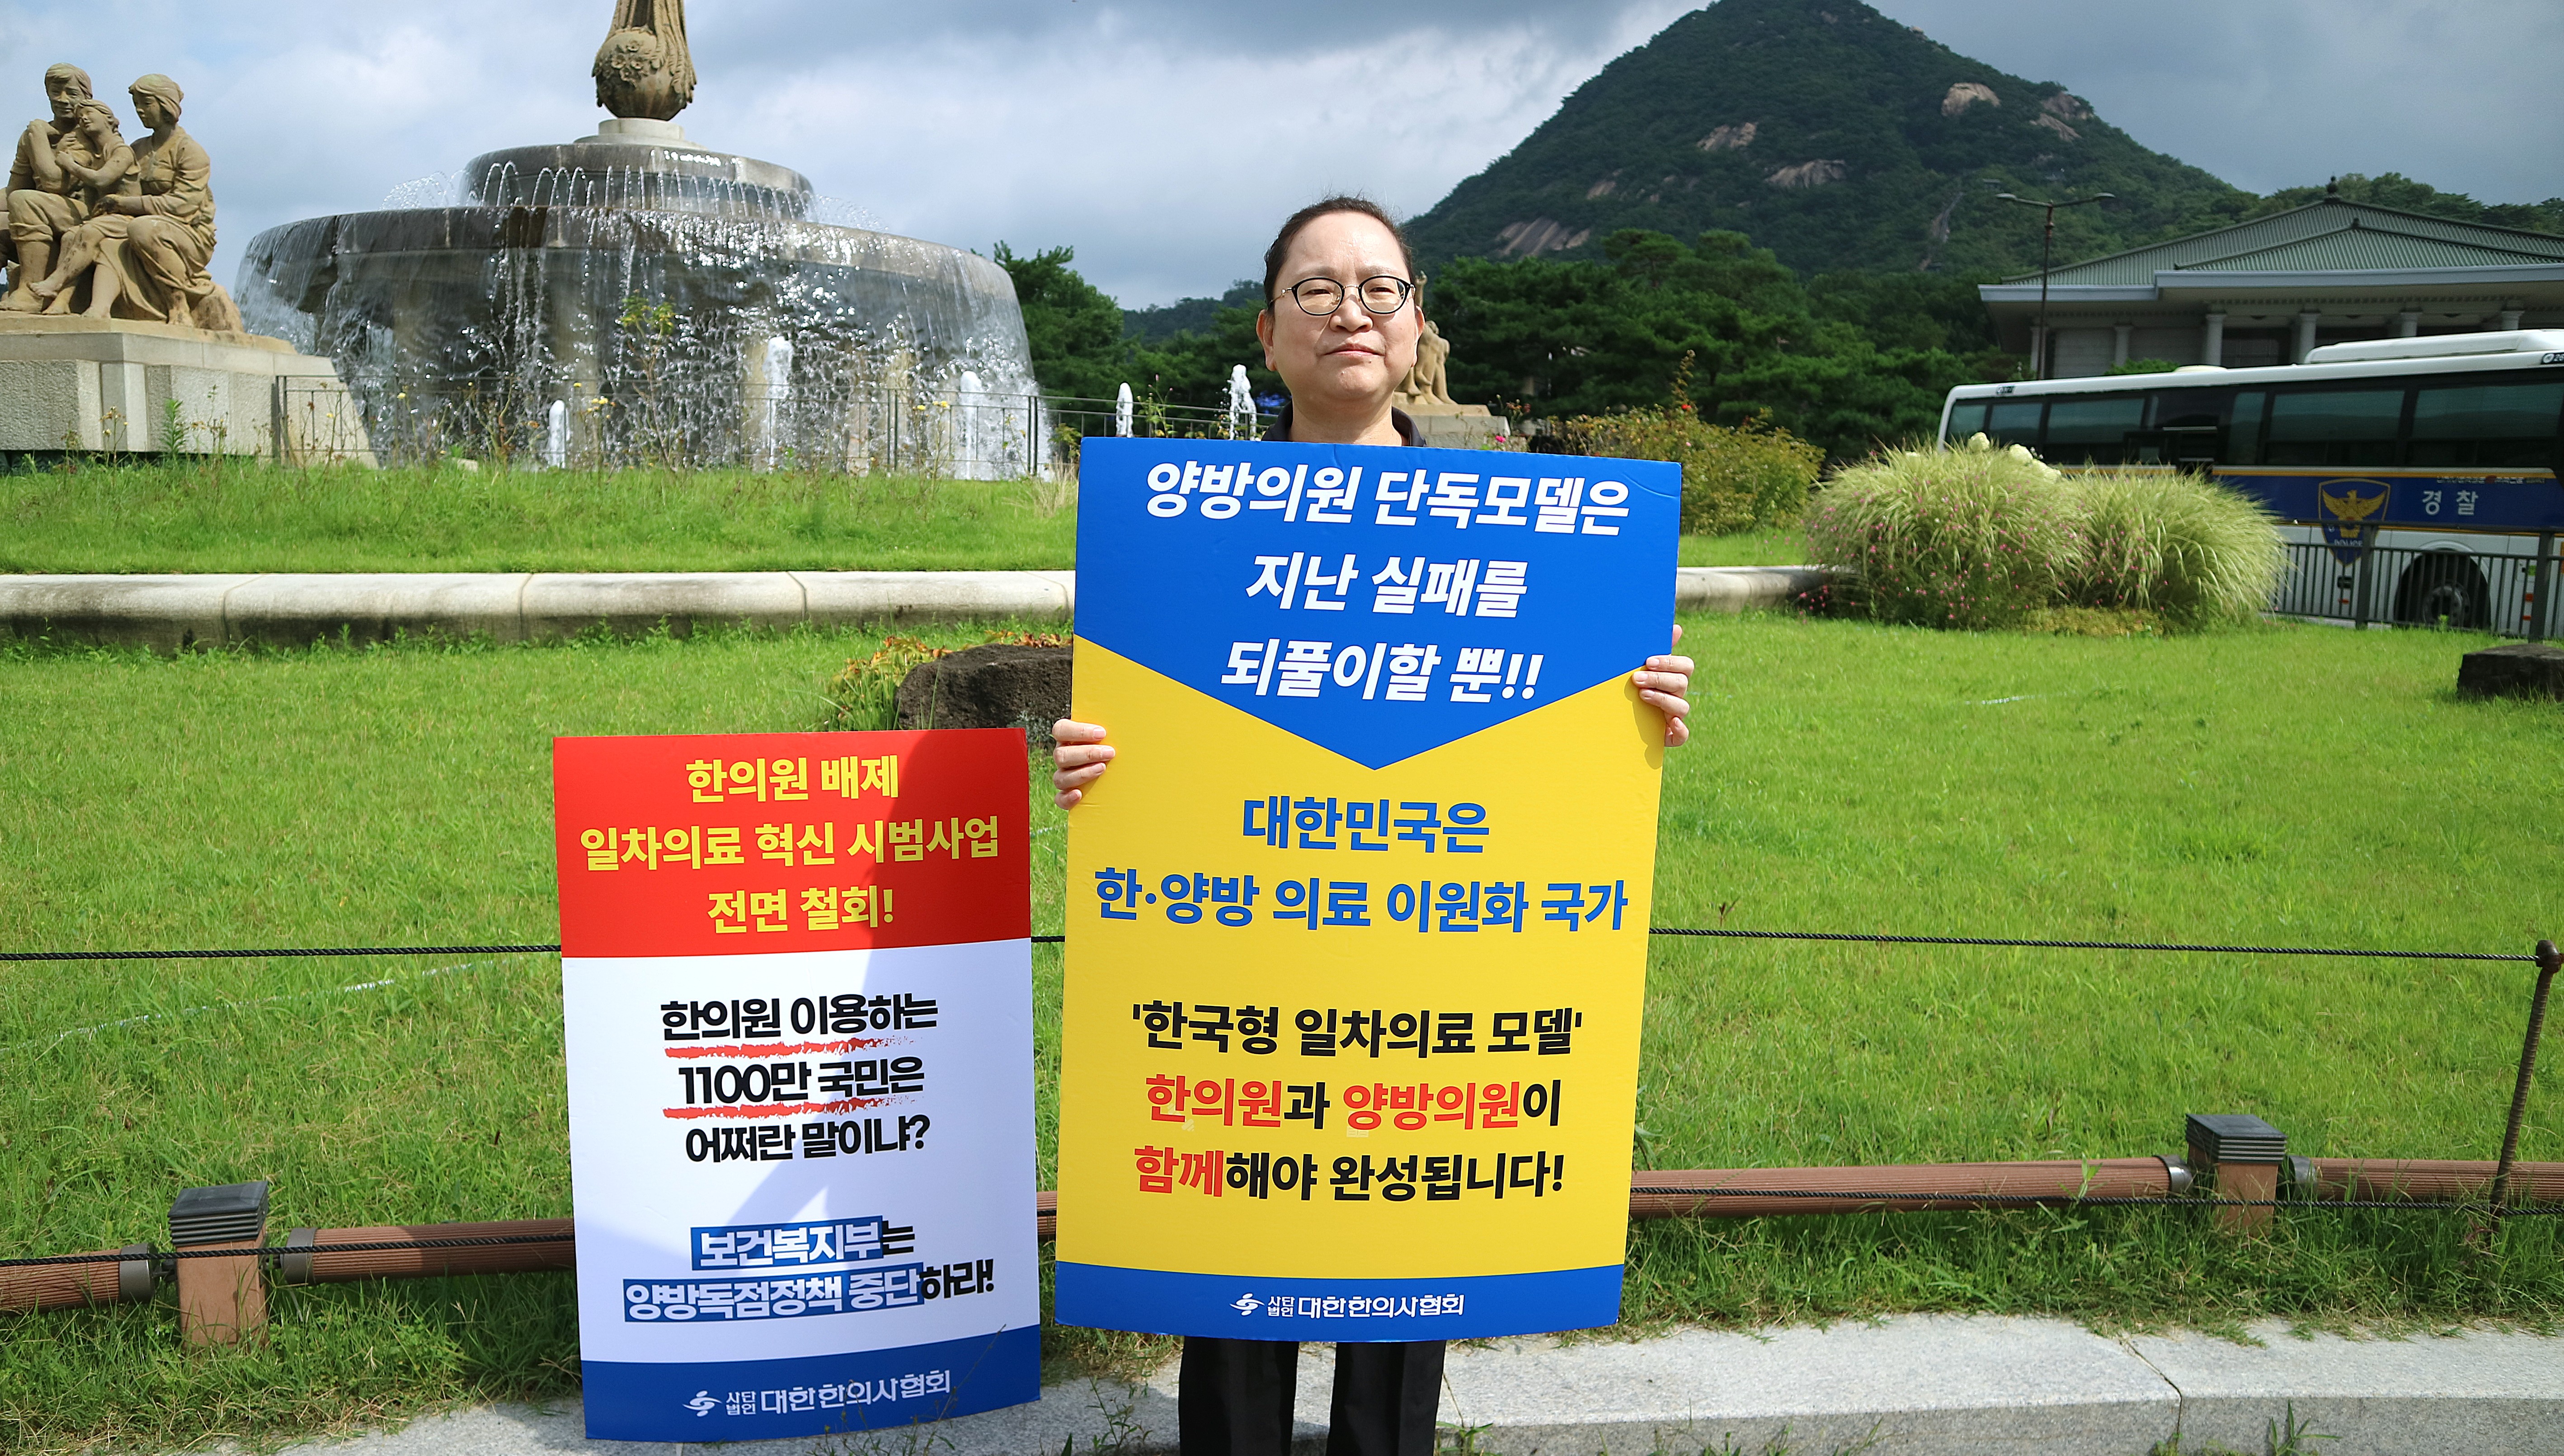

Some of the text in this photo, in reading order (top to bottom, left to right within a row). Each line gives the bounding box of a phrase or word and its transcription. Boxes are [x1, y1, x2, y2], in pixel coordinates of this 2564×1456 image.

[1147, 460, 1629, 535] 양방의원 단독모델은
[1246, 552, 1528, 618] 지난 실패를
[1221, 639, 1544, 703] 되풀이할 뿐!!
[686, 755, 899, 803] 한의원 배제
[580, 816, 998, 871] 일차의료 혁신 시범사업
[1244, 796, 1489, 853] 대한민국은
[707, 885, 893, 934] 전면 철회!
[1274, 878, 1370, 930] 의료
[1388, 881, 1529, 932] 이원화
[1542, 880, 1628, 931] 국가
[661, 993, 938, 1041] 한의원 이용하는
[1295, 1009, 1476, 1058] 일차의료
[678, 1057, 925, 1104] 1100만 국민은
[1147, 1075, 1561, 1131] 한의원과 양방의원이
[686, 1114, 930, 1163] 어쩌란 말이냐?
[1135, 1146, 1564, 1202] 함께해야 완성됩니다!
[700, 1219, 916, 1267] 보건복지부는
[626, 1258, 994, 1321] 양방독점정책 중단하라!
[1267, 1306, 1293, 1317] 법인
[1268, 1296, 1295, 1307] 사단
[1298, 1294, 1464, 1319] 대한한의사협회
[726, 1391, 756, 1404] 사단
[726, 1403, 756, 1415] 법인
[761, 1370, 950, 1414] 대한한의사협회
